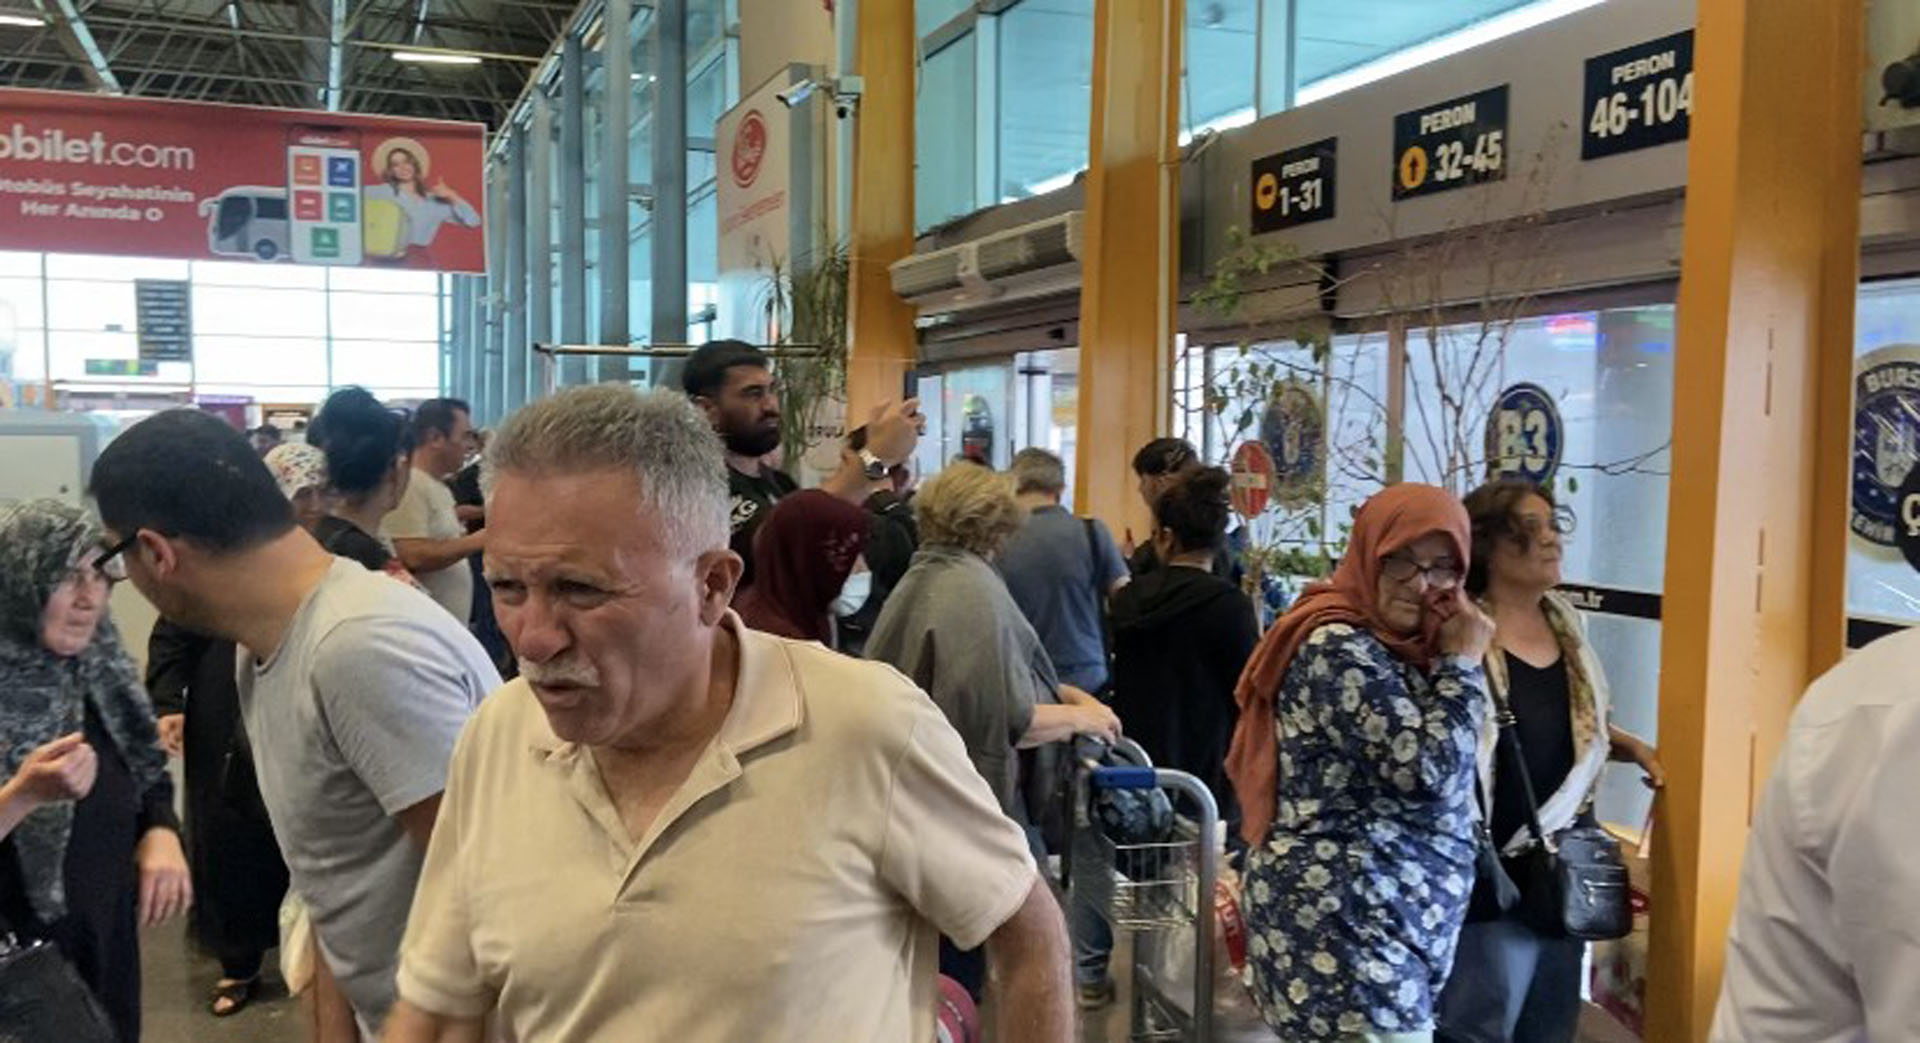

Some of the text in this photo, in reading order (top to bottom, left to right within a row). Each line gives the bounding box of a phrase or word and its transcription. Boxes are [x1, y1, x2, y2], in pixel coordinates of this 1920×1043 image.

[1612, 51, 1675, 84] PERON
[1421, 102, 1475, 134] PERON
[1590, 72, 1693, 137] 46-104
[1281, 157, 1320, 179] PERON
[1434, 129, 1504, 182] 32-45
[21, 201, 60, 216] Her
[1280, 178, 1322, 216] 1-31
